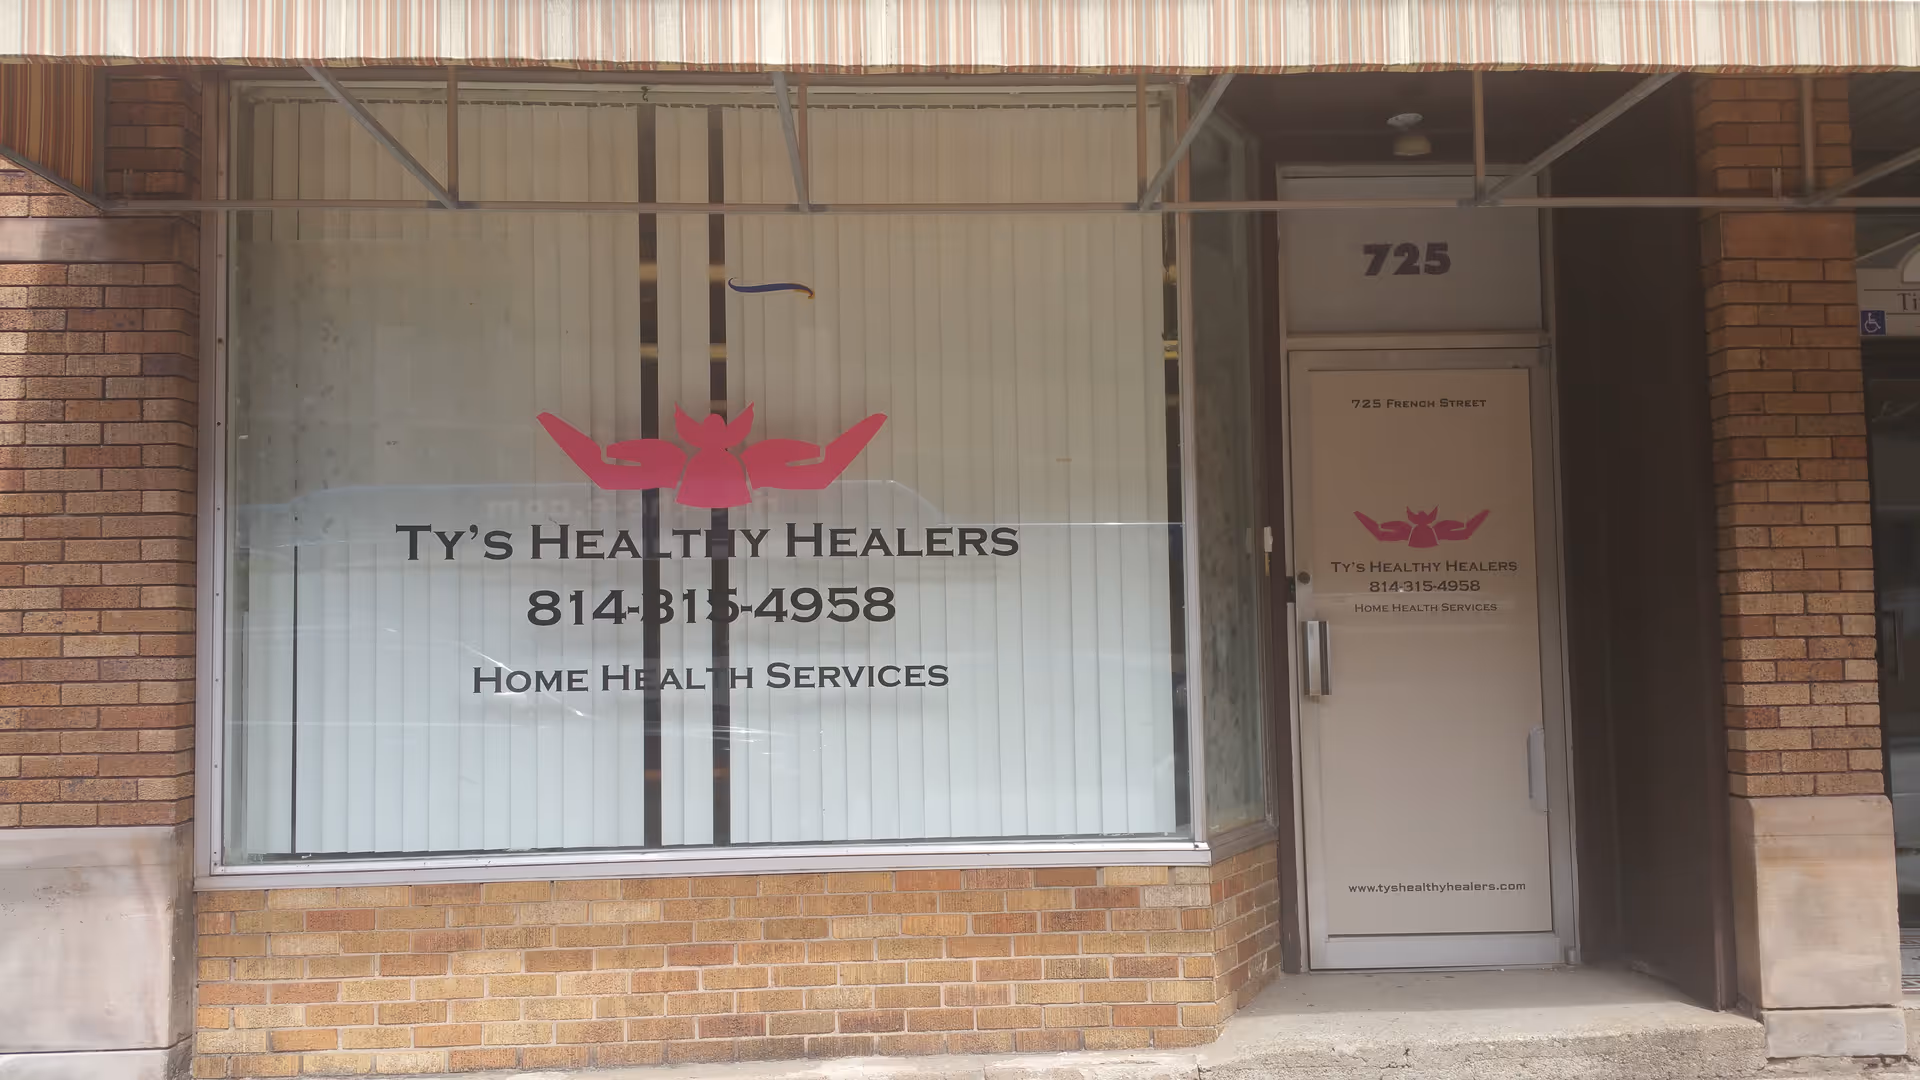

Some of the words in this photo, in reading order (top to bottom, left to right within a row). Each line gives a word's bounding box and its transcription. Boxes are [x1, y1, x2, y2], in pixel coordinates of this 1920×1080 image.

[1363, 242, 1451, 276] 725
[1897, 292, 1920, 311] Ti
[1351, 399, 1381, 409] 725
[1369, 580, 1480, 592] 814-315-4958
[527, 586, 897, 626] 814-315-4958
[1348, 881, 1526, 893] www.tyshealthyhealers.com
